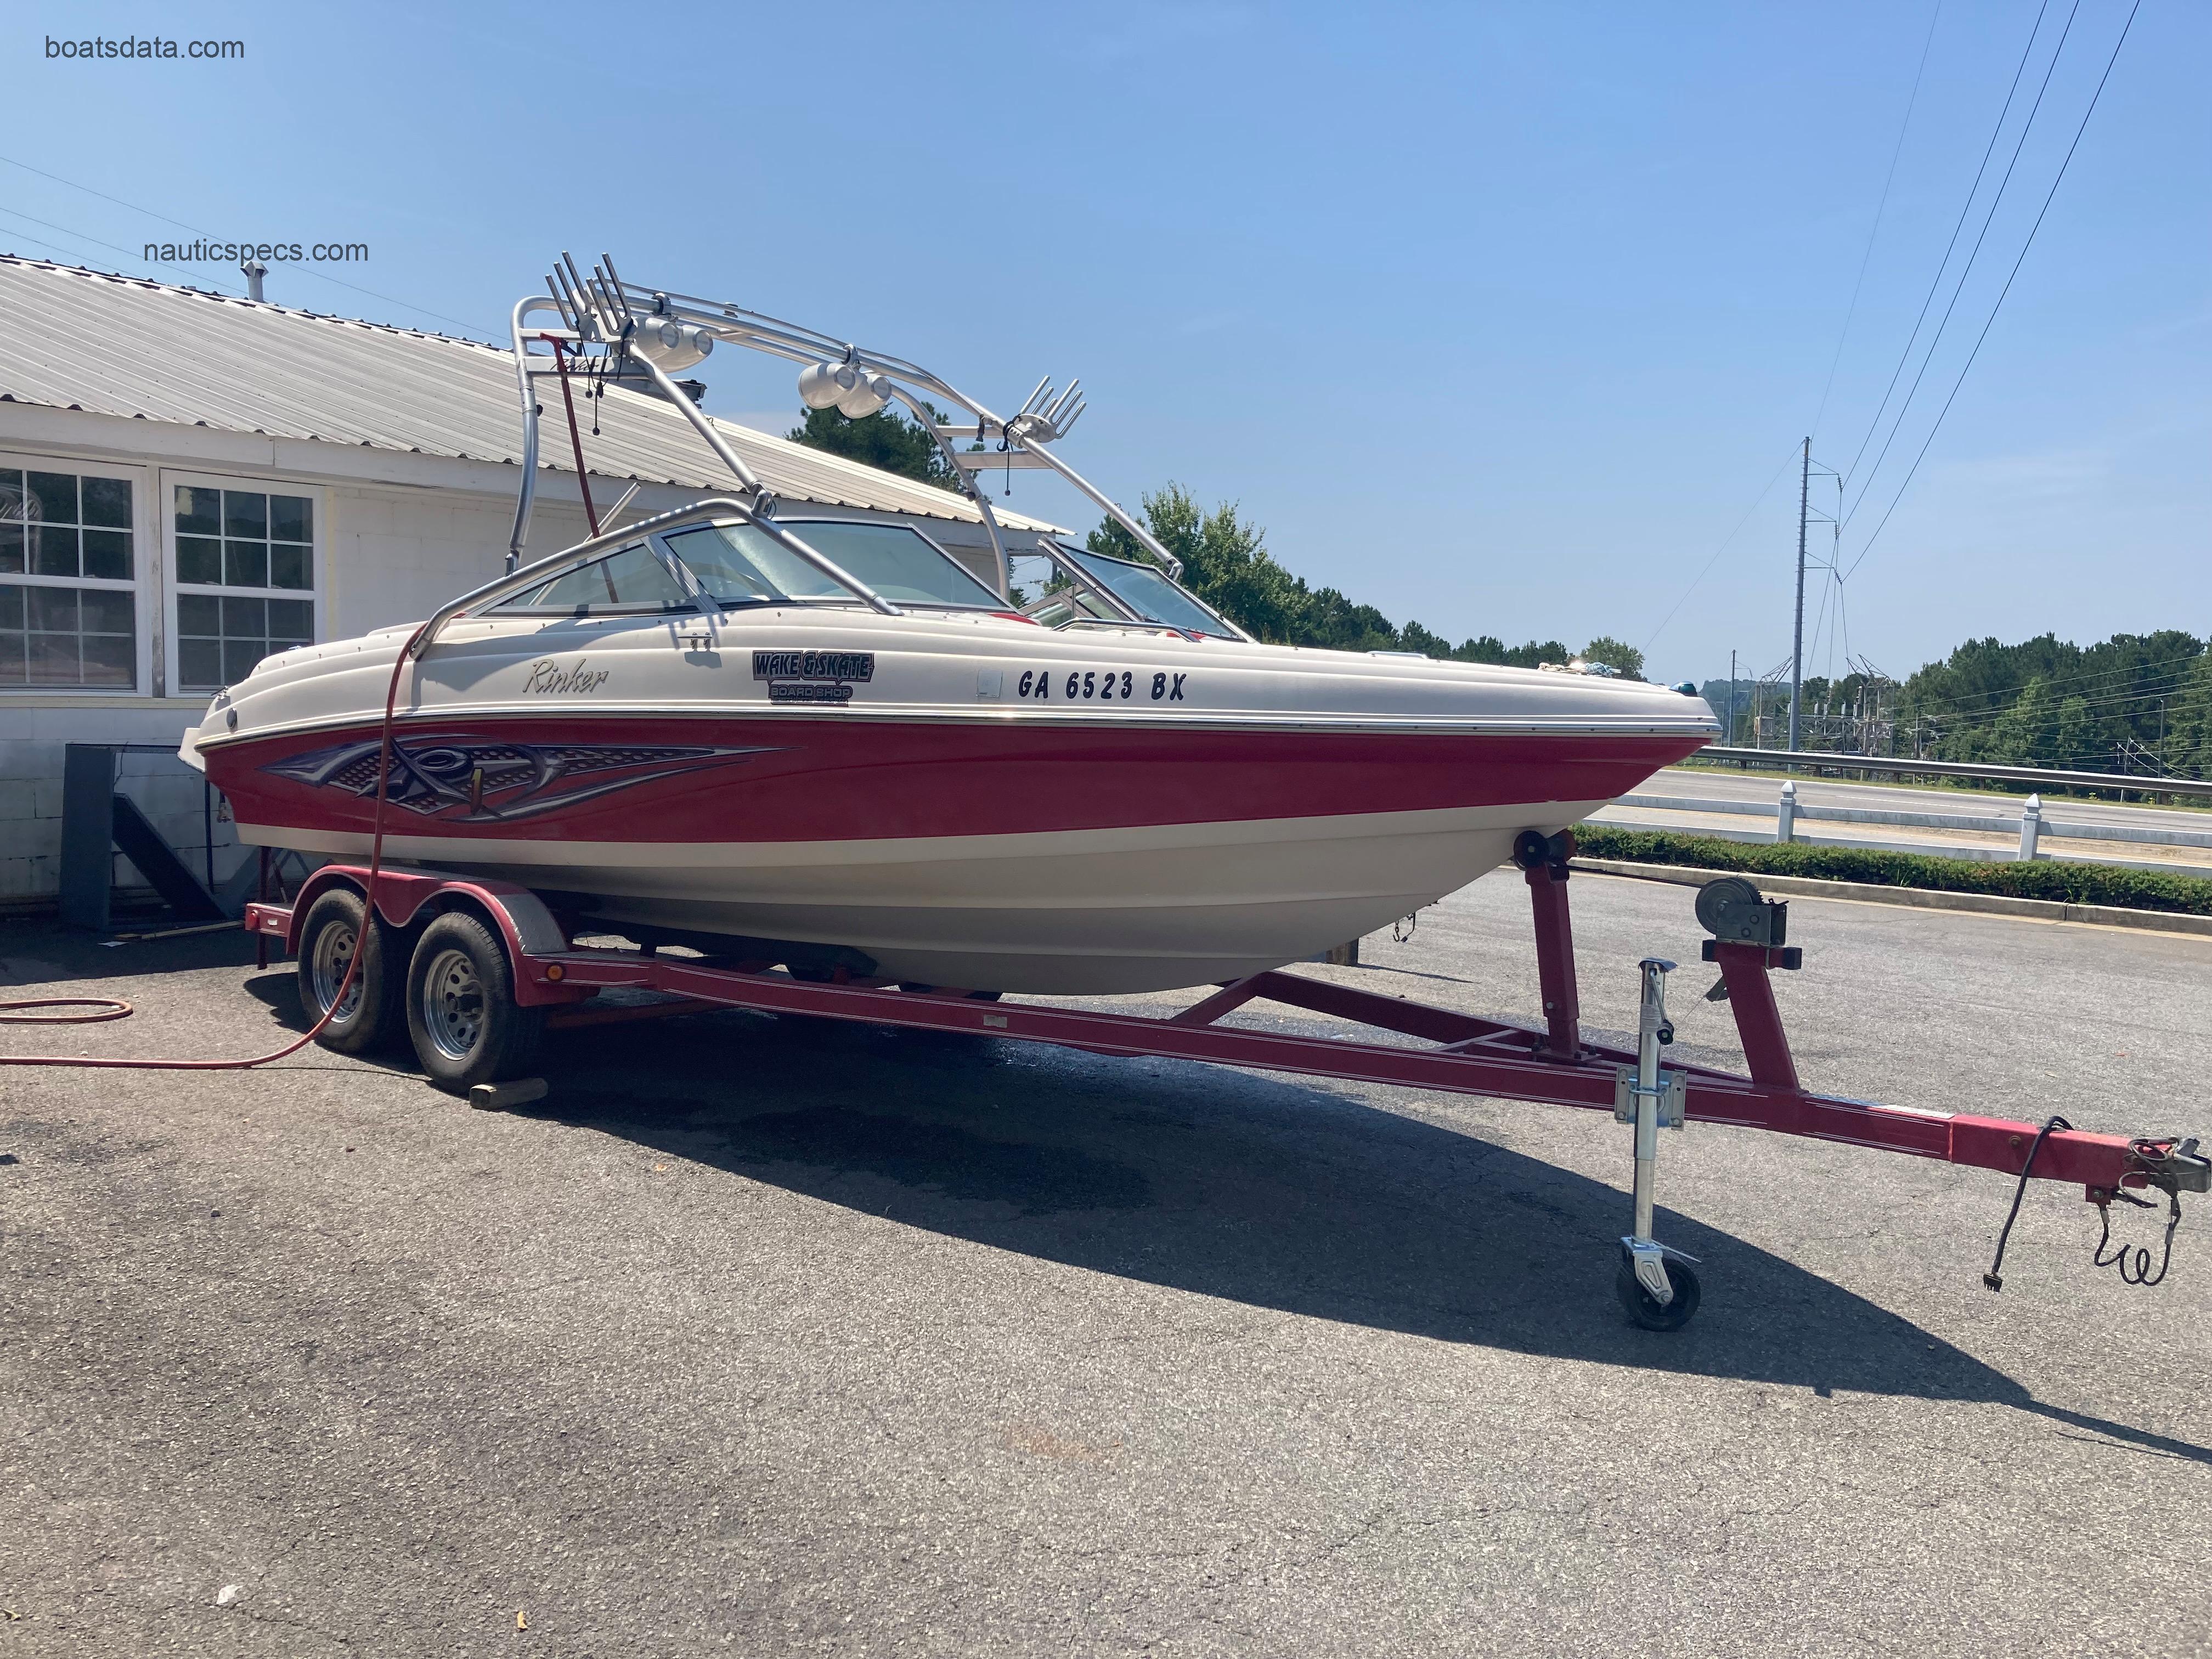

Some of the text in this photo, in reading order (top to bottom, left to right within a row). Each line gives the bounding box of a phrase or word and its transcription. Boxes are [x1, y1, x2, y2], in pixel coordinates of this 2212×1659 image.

[522, 659, 608, 693] Rinker
[755, 654, 799, 676] WAKE
[816, 654, 871, 678] SKATE
[771, 686, 850, 698] BOARD SHOP
[1018, 670, 1187, 701] GA 6523 BX
